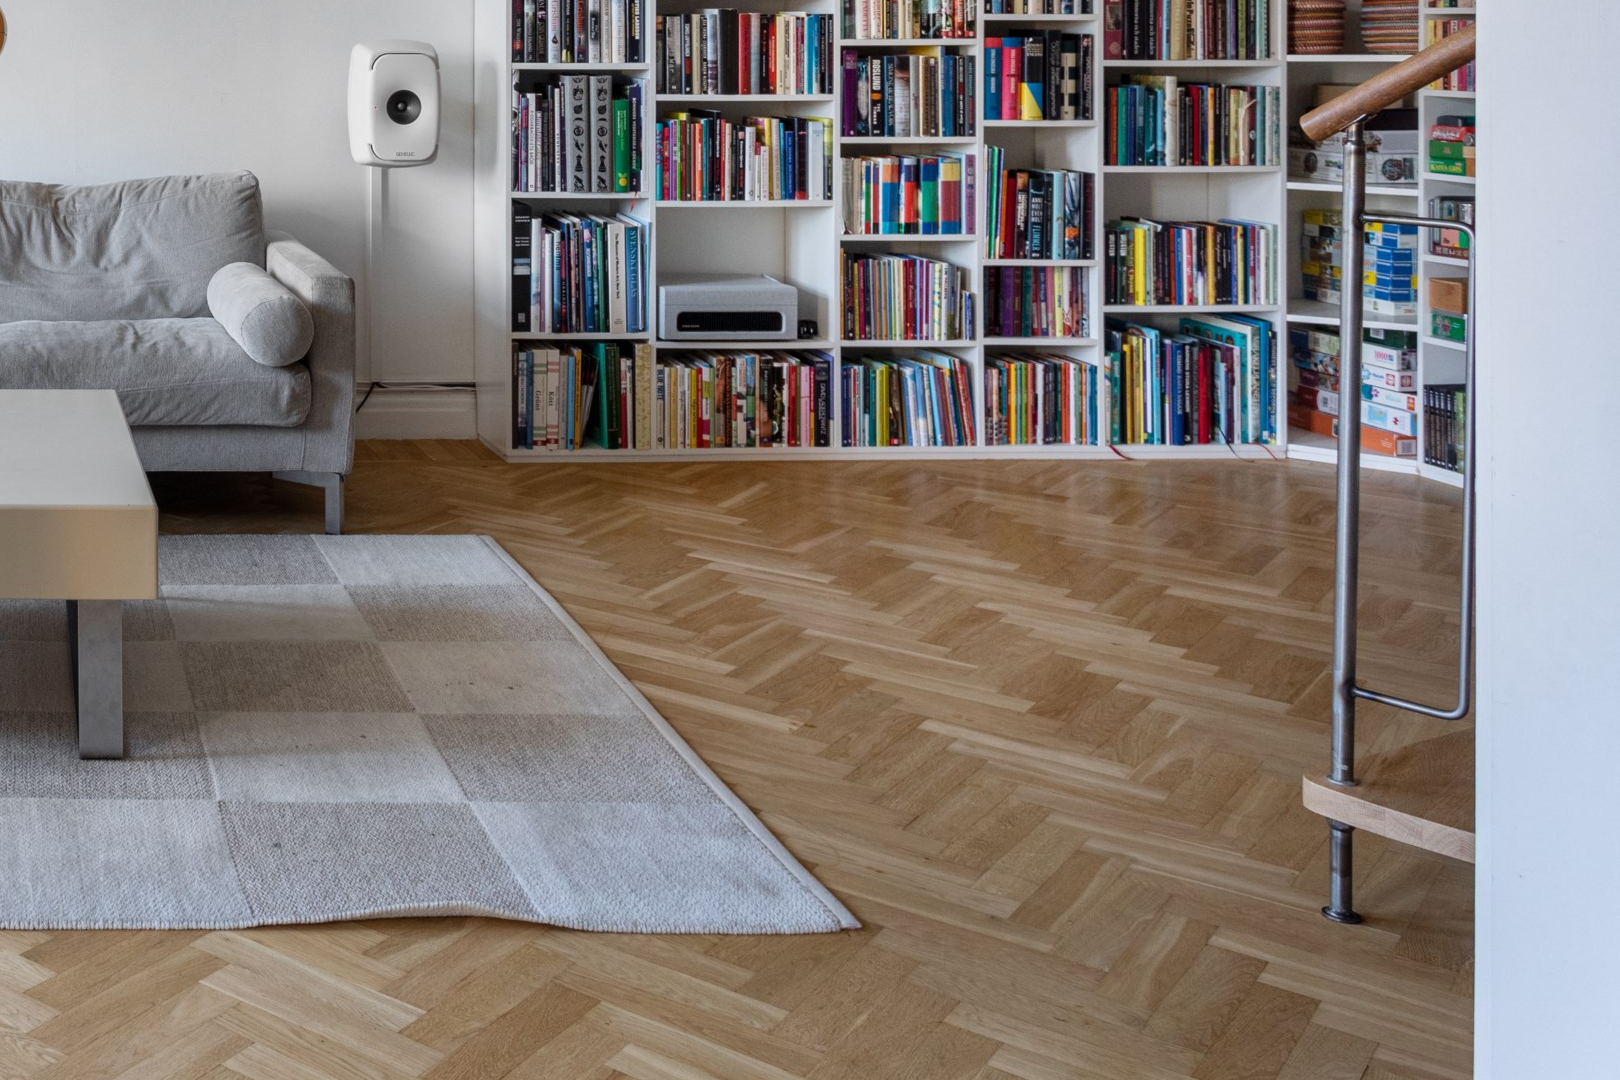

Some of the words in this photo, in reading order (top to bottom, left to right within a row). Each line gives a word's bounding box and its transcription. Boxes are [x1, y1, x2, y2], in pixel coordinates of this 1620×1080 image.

[551, 0, 559, 32] Grisham
[872, 59, 880, 91] ROSLUND
[1032, 225, 1041, 251] FLIMMER
